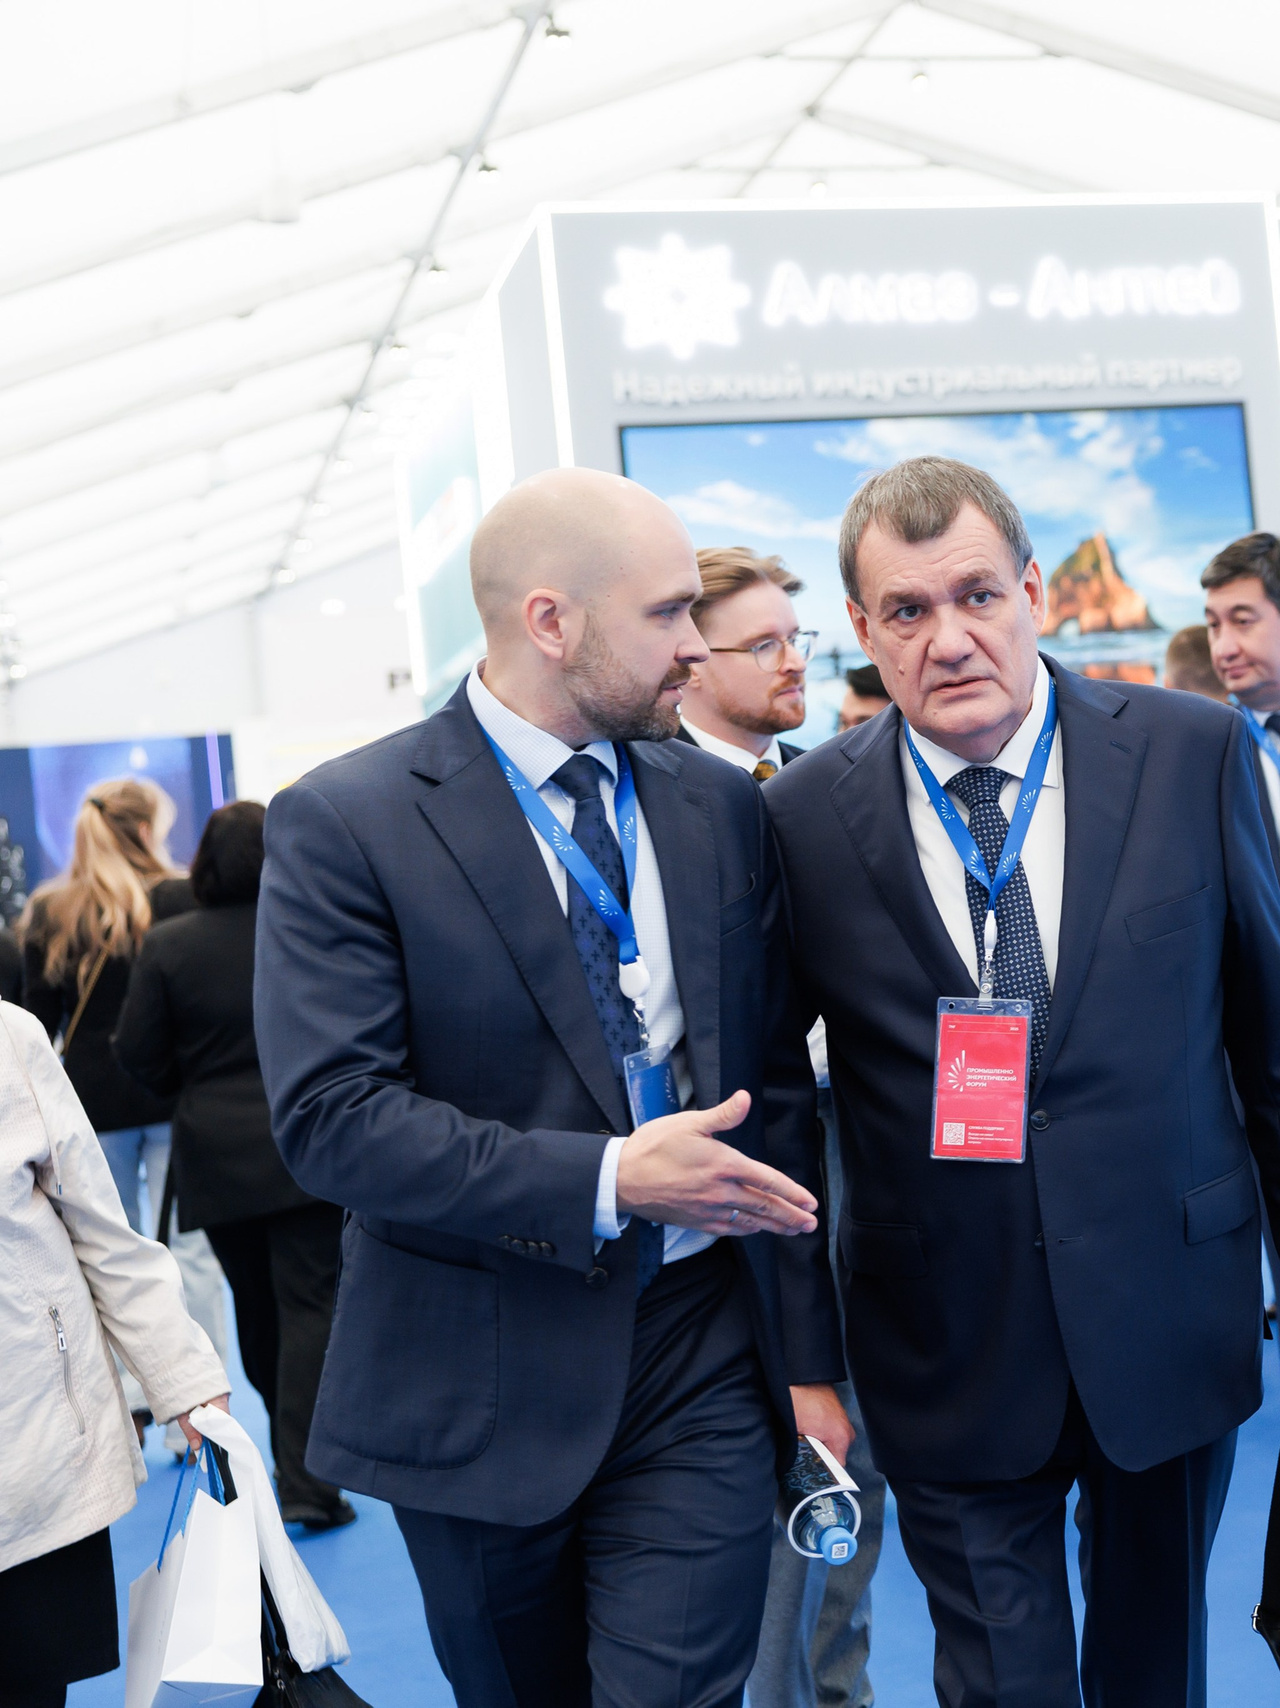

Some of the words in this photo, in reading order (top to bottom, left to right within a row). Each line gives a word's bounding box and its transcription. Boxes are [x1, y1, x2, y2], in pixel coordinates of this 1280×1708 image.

[613, 362, 803, 404] Надежный
[812, 353, 1099, 401] индустриальный
[1106, 357, 1242, 391] партнер
